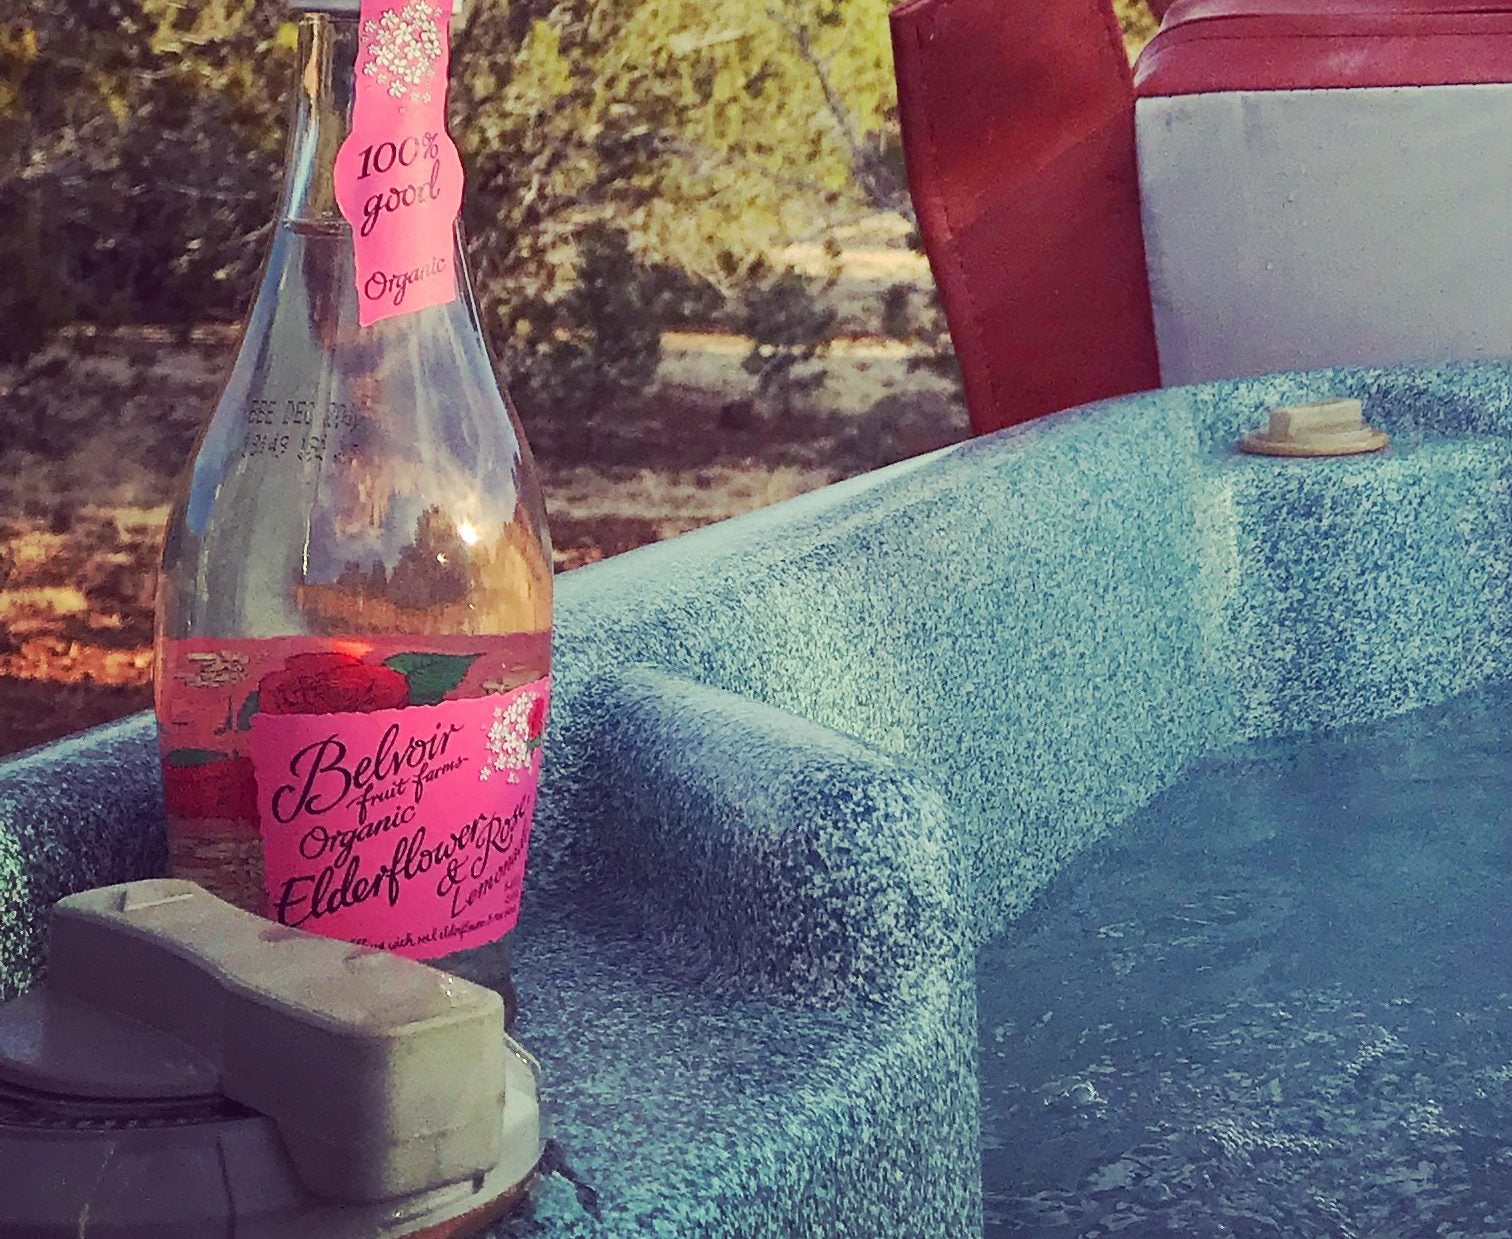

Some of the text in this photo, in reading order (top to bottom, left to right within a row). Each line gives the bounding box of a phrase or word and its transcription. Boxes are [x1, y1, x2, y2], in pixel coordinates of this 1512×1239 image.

[357, 131, 439, 180] 100%
[360, 160, 441, 237] good
[364, 256, 446, 305] Organic
[271, 723, 465, 824] Belvoir
[346, 757, 469, 824] fruit farms
[300, 806, 415, 867] Organic
[274, 812, 487, 929] Elderflower
[437, 855, 469, 897] &
